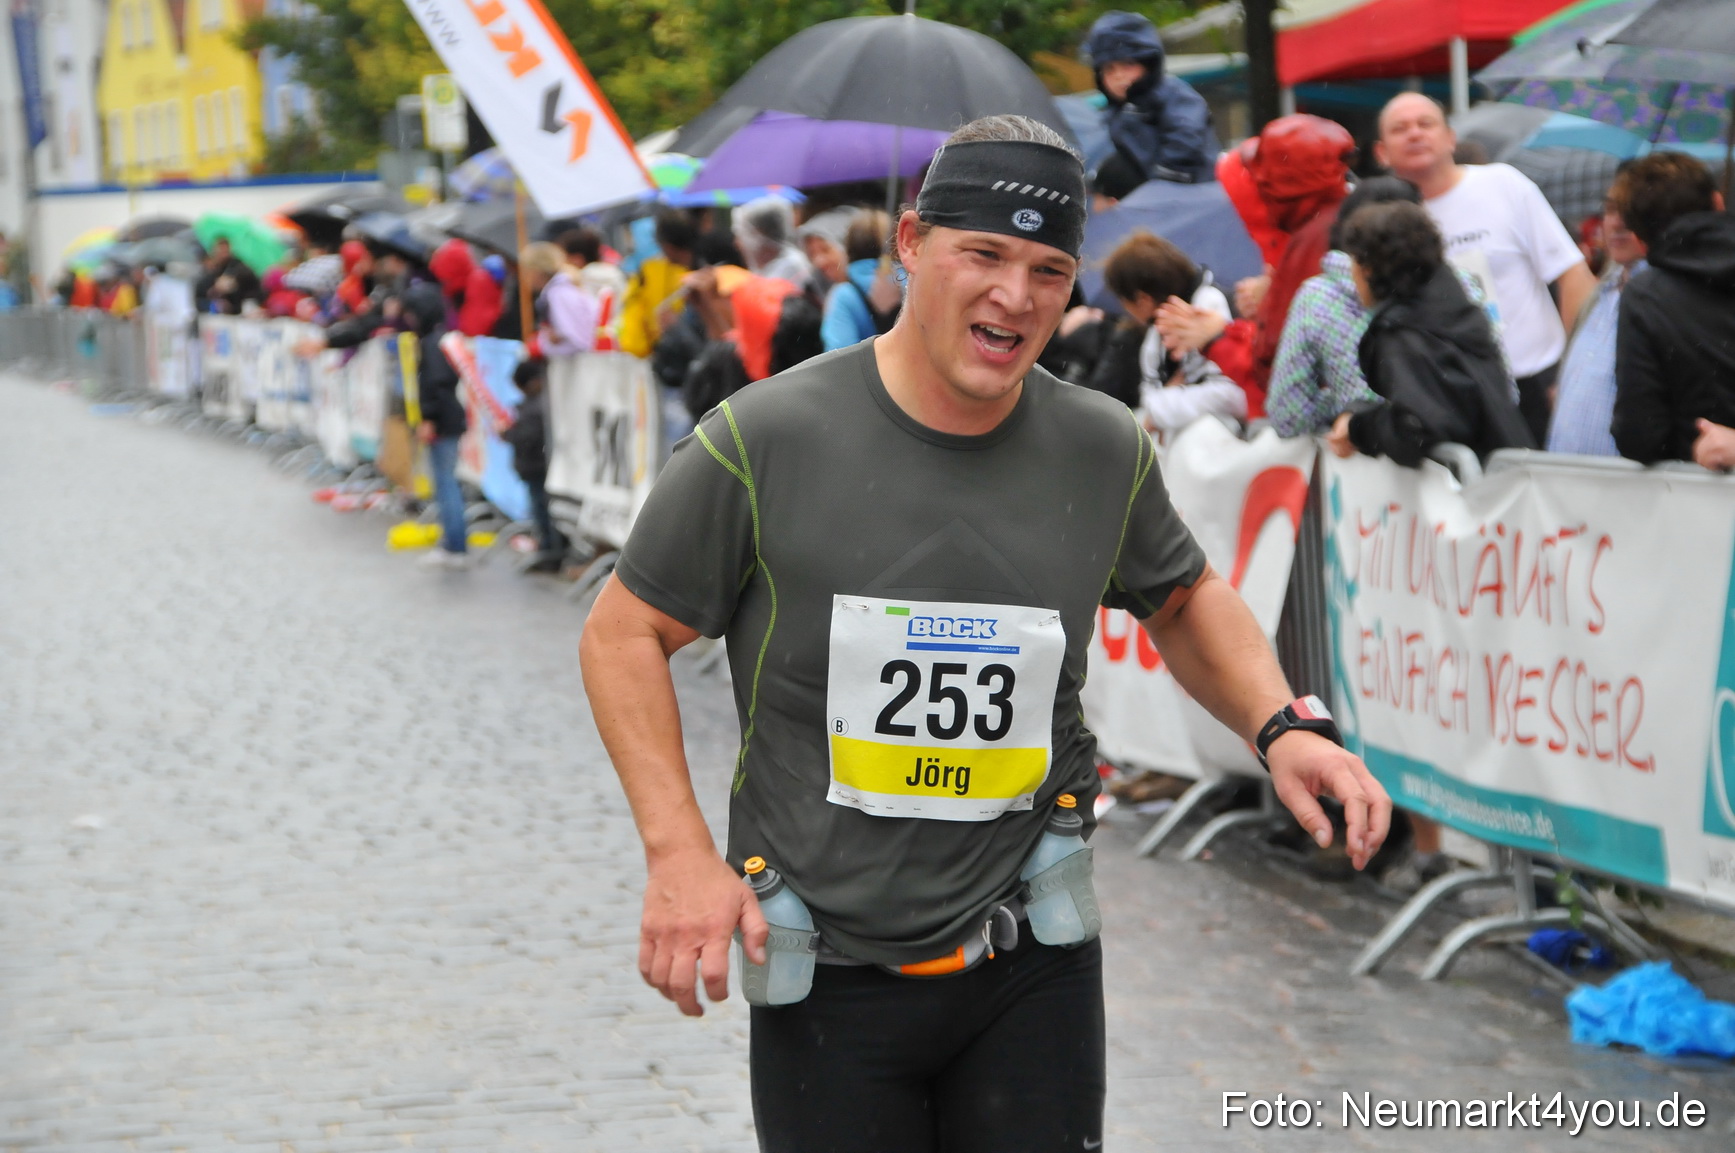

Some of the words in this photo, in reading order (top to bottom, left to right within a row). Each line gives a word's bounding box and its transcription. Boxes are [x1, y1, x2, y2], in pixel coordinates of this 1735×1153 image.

[907, 616, 999, 639] BOCK
[874, 659, 1016, 742] 253
[905, 757, 971, 796] Jörg
